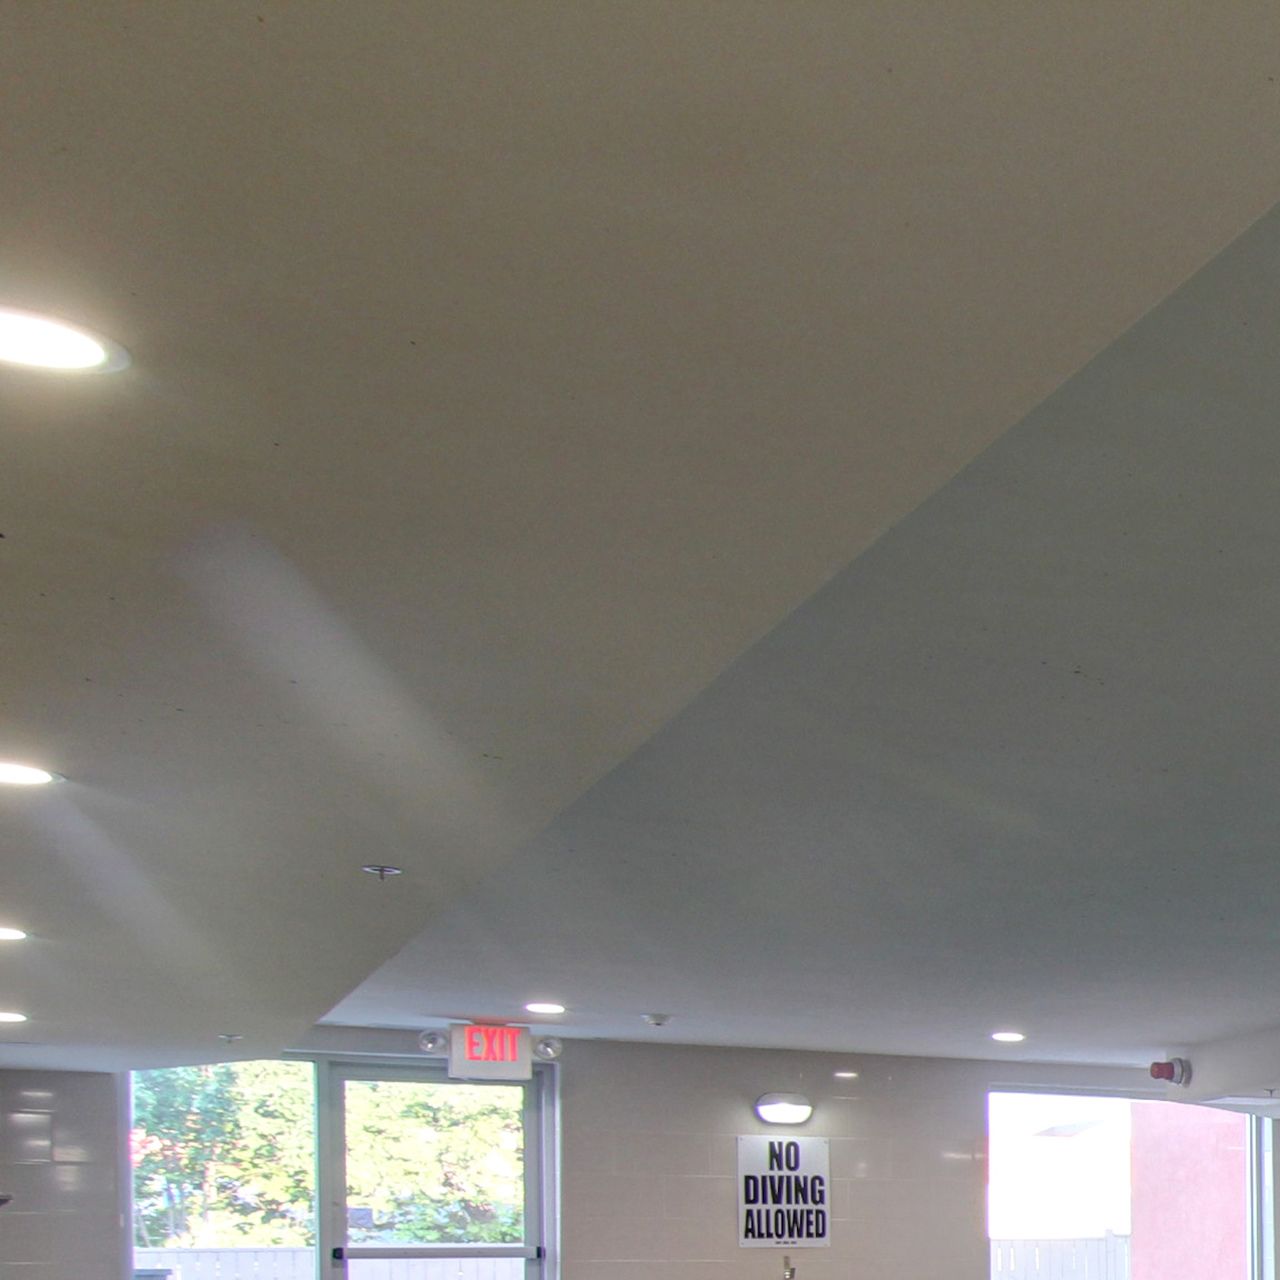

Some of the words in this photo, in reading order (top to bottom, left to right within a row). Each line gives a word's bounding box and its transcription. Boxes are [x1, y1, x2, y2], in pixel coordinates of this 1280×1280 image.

[464, 1026, 522, 1062] EXIT
[769, 1141, 800, 1171] NO
[744, 1175, 825, 1205] DIVING
[744, 1209, 826, 1239] ALLOWED
